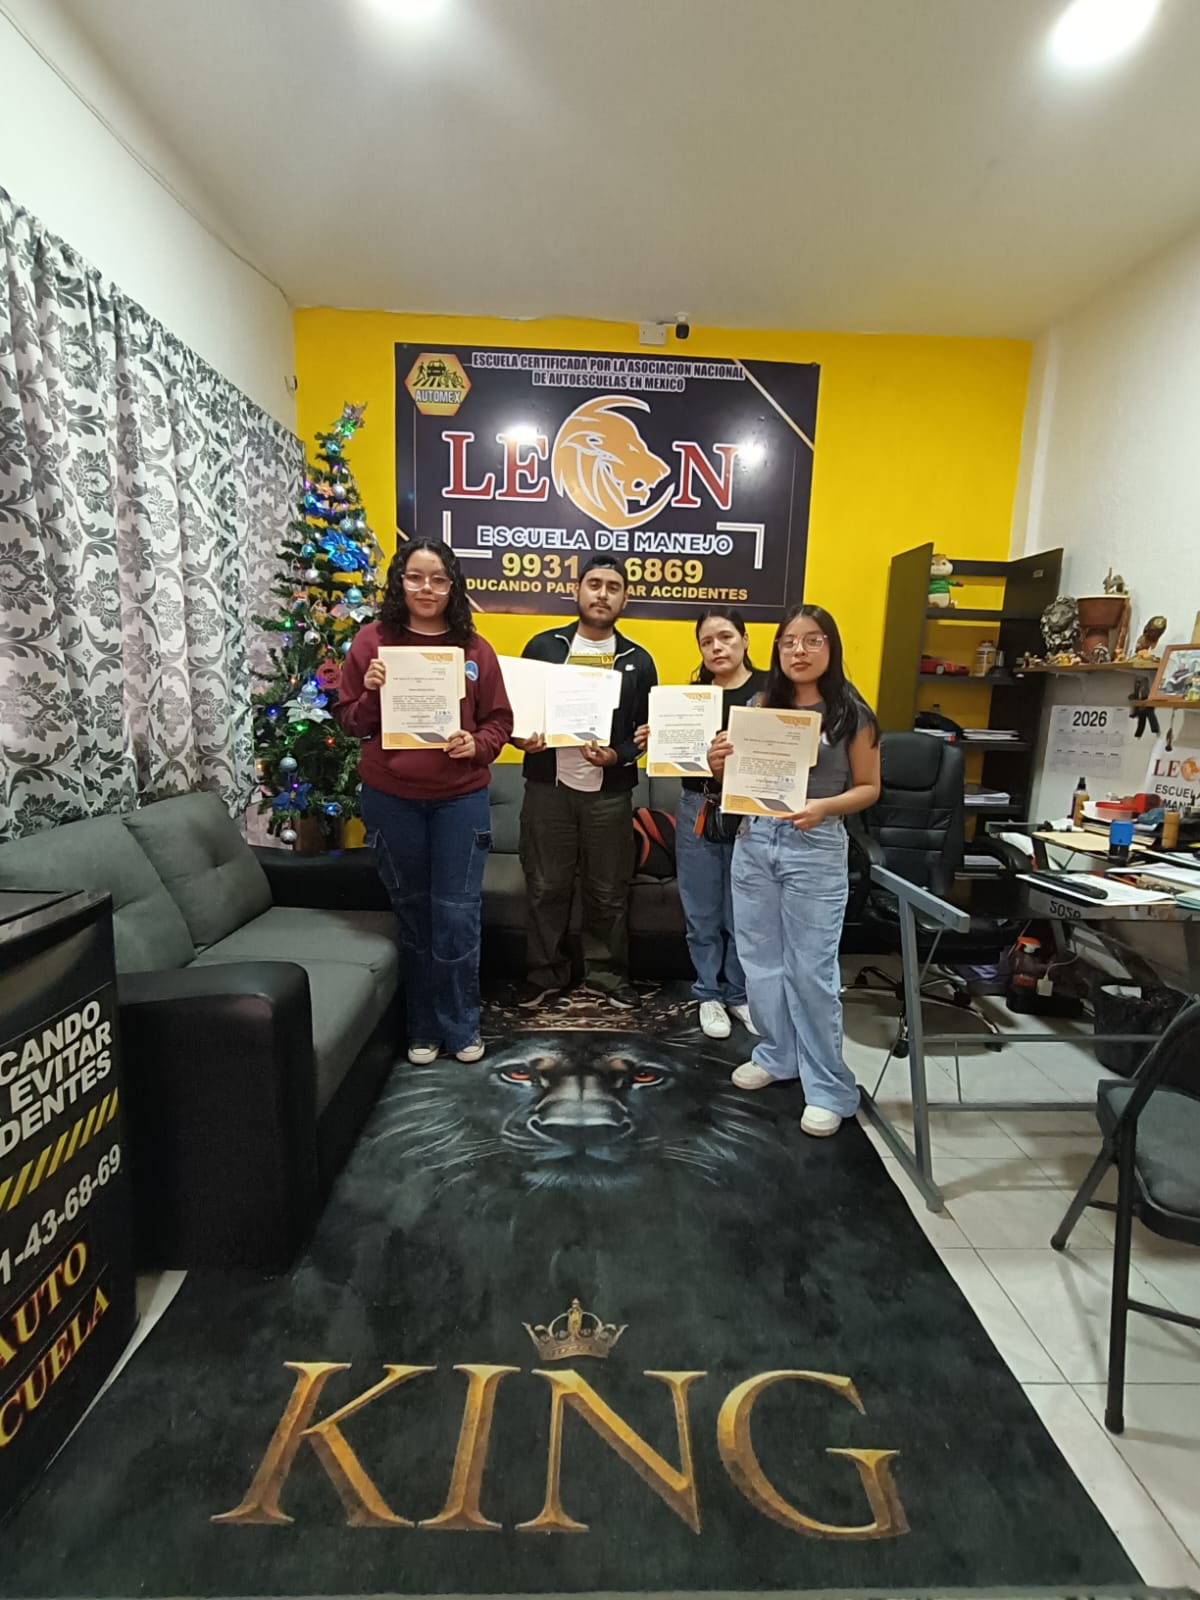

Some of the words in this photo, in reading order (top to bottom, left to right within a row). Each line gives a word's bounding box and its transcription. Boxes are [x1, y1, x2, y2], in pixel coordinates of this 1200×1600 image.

[472, 352, 518, 369] ESCUELA
[520, 354, 587, 371] CERTIFICADA
[590, 358, 611, 373] POR
[612, 359, 627, 374] LA
[627, 361, 691, 378] ASOCIACION
[693, 363, 745, 380] NACIONAL
[415, 389, 462, 404] AUTOMEX
[532, 372, 547, 386] DE
[548, 373, 627, 389] AUTOESCUELAS
[629, 376, 642, 389] EN
[644, 377, 685, 392] MEXICO
[477, 525, 591, 549] ESCUELA
[595, 531, 629, 551] DE
[634, 532, 733, 555] MANEJO
[466, 578, 542, 592] DUCANDO
[547, 582, 578, 594] PAR
[651, 585, 747, 600] ACCIDENTES
[1073, 711, 1108, 727] 2026
[0, 1001, 100, 1086] CANDO
[10, 1021, 112, 1113] EVITAR
[0, 1050, 111, 1158] DENTES
[0, 1285, 110, 1447] CUELA
[210, 1361, 909, 1540] KING
